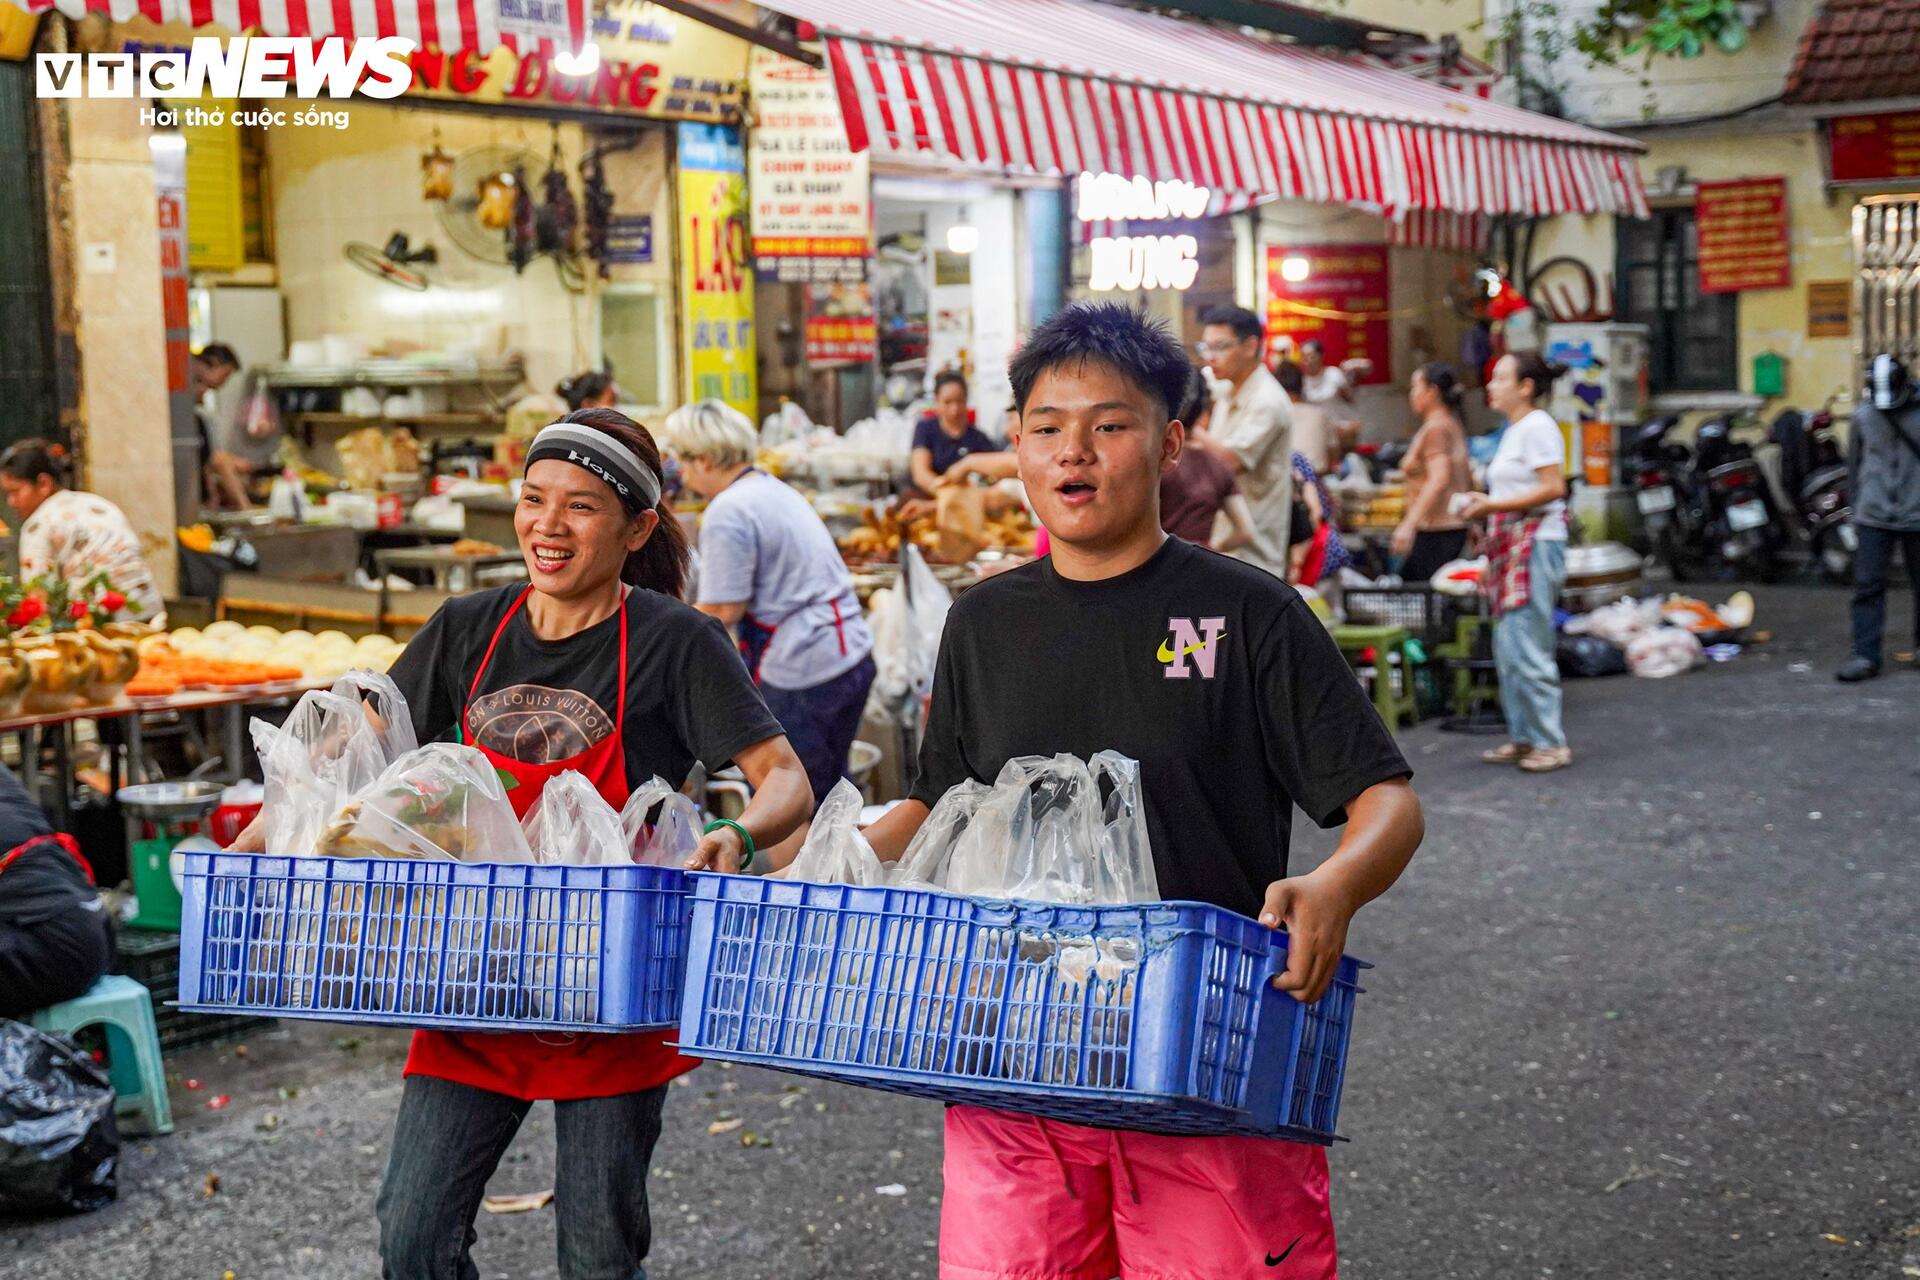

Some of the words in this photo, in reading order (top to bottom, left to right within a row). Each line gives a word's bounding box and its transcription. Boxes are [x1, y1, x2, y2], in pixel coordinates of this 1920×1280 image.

[568, 450, 629, 496] Hope
[503, 693, 551, 706] LOUIS
[556, 696, 606, 739] VUITTON
